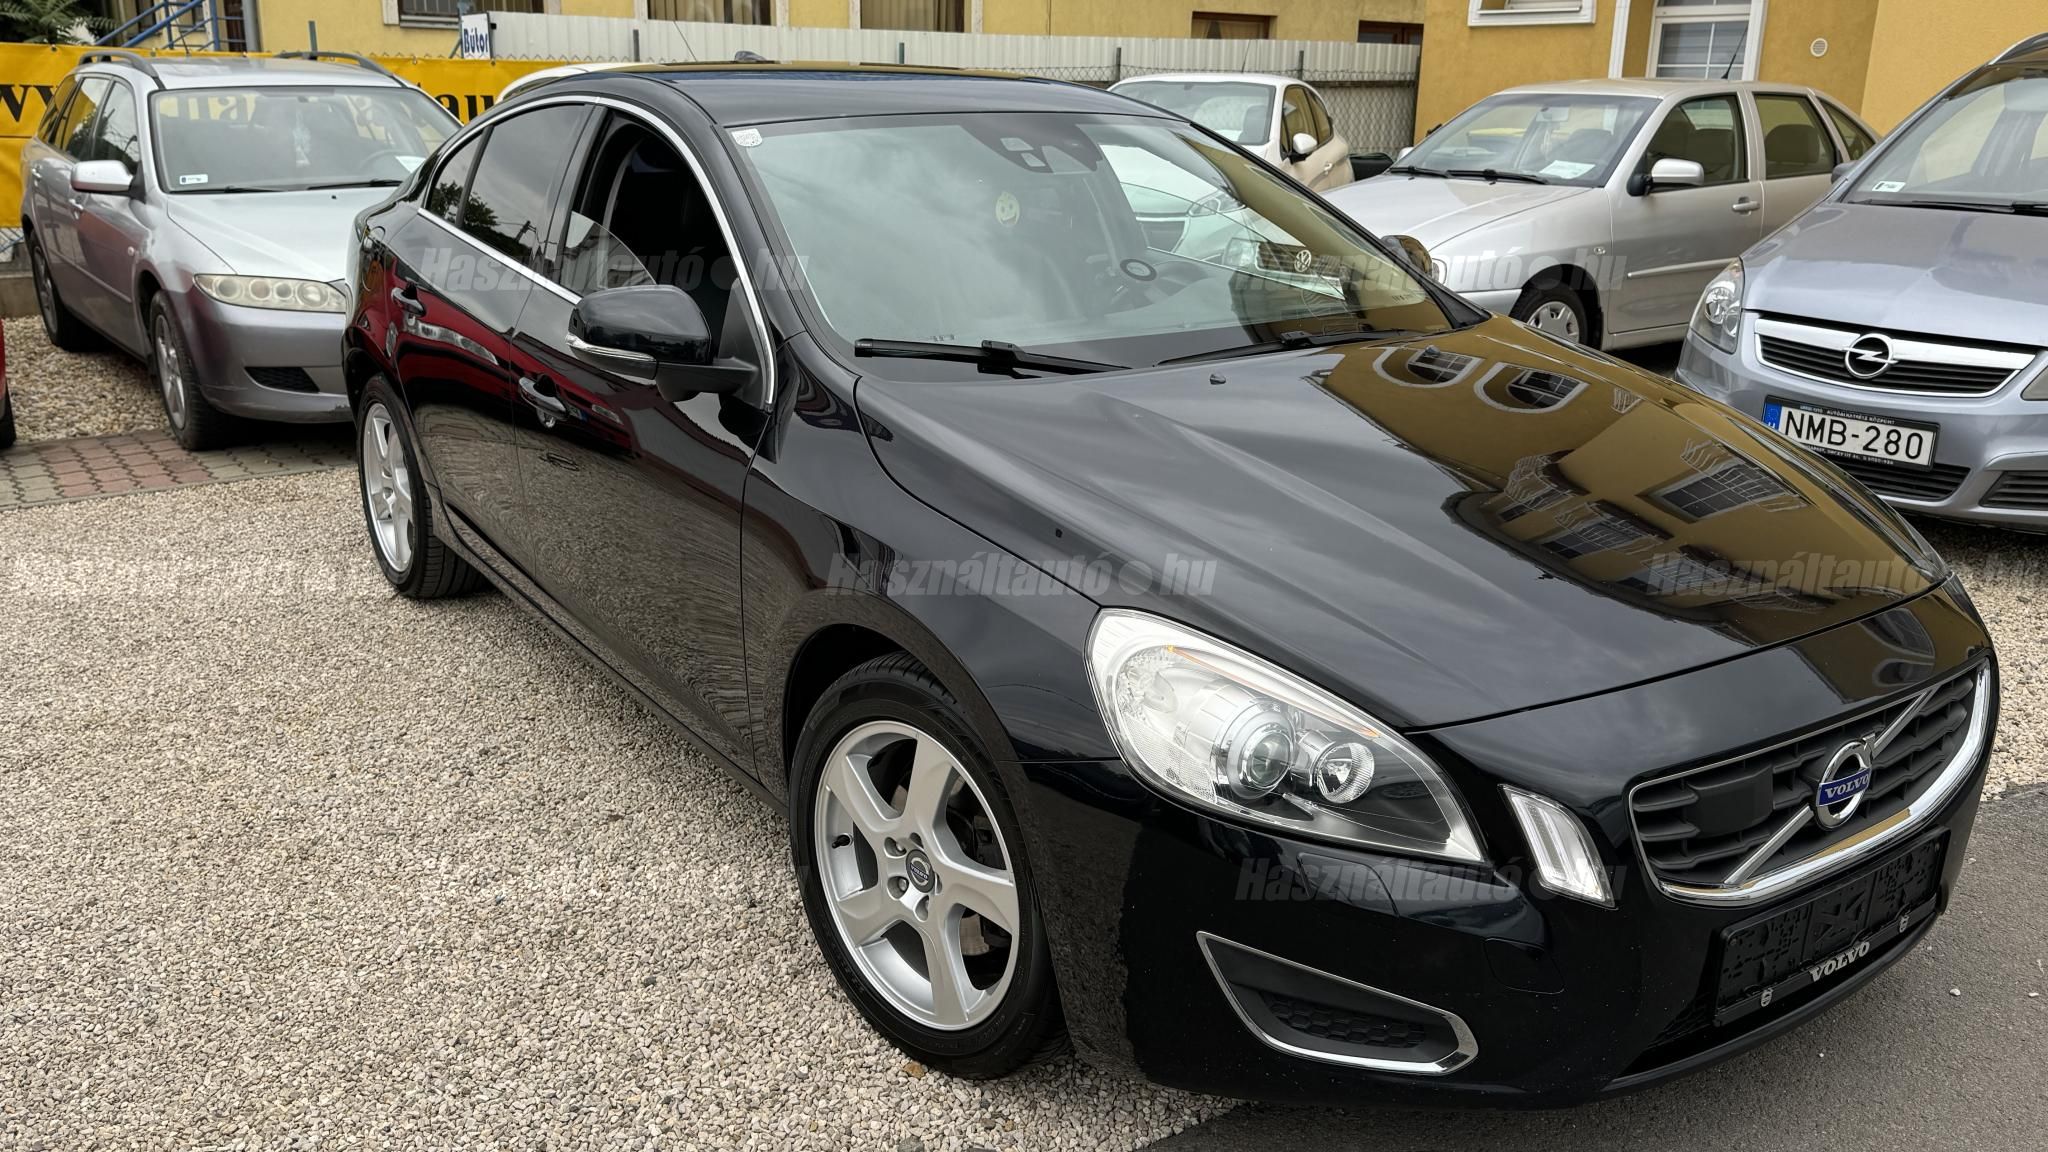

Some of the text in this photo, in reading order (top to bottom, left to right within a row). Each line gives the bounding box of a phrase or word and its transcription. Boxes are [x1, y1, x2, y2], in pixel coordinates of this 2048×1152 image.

[1785, 410, 1924, 460] NMB-280
[1825, 774, 1869, 798] VOLVO
[1809, 941, 1870, 982] VOLVO
